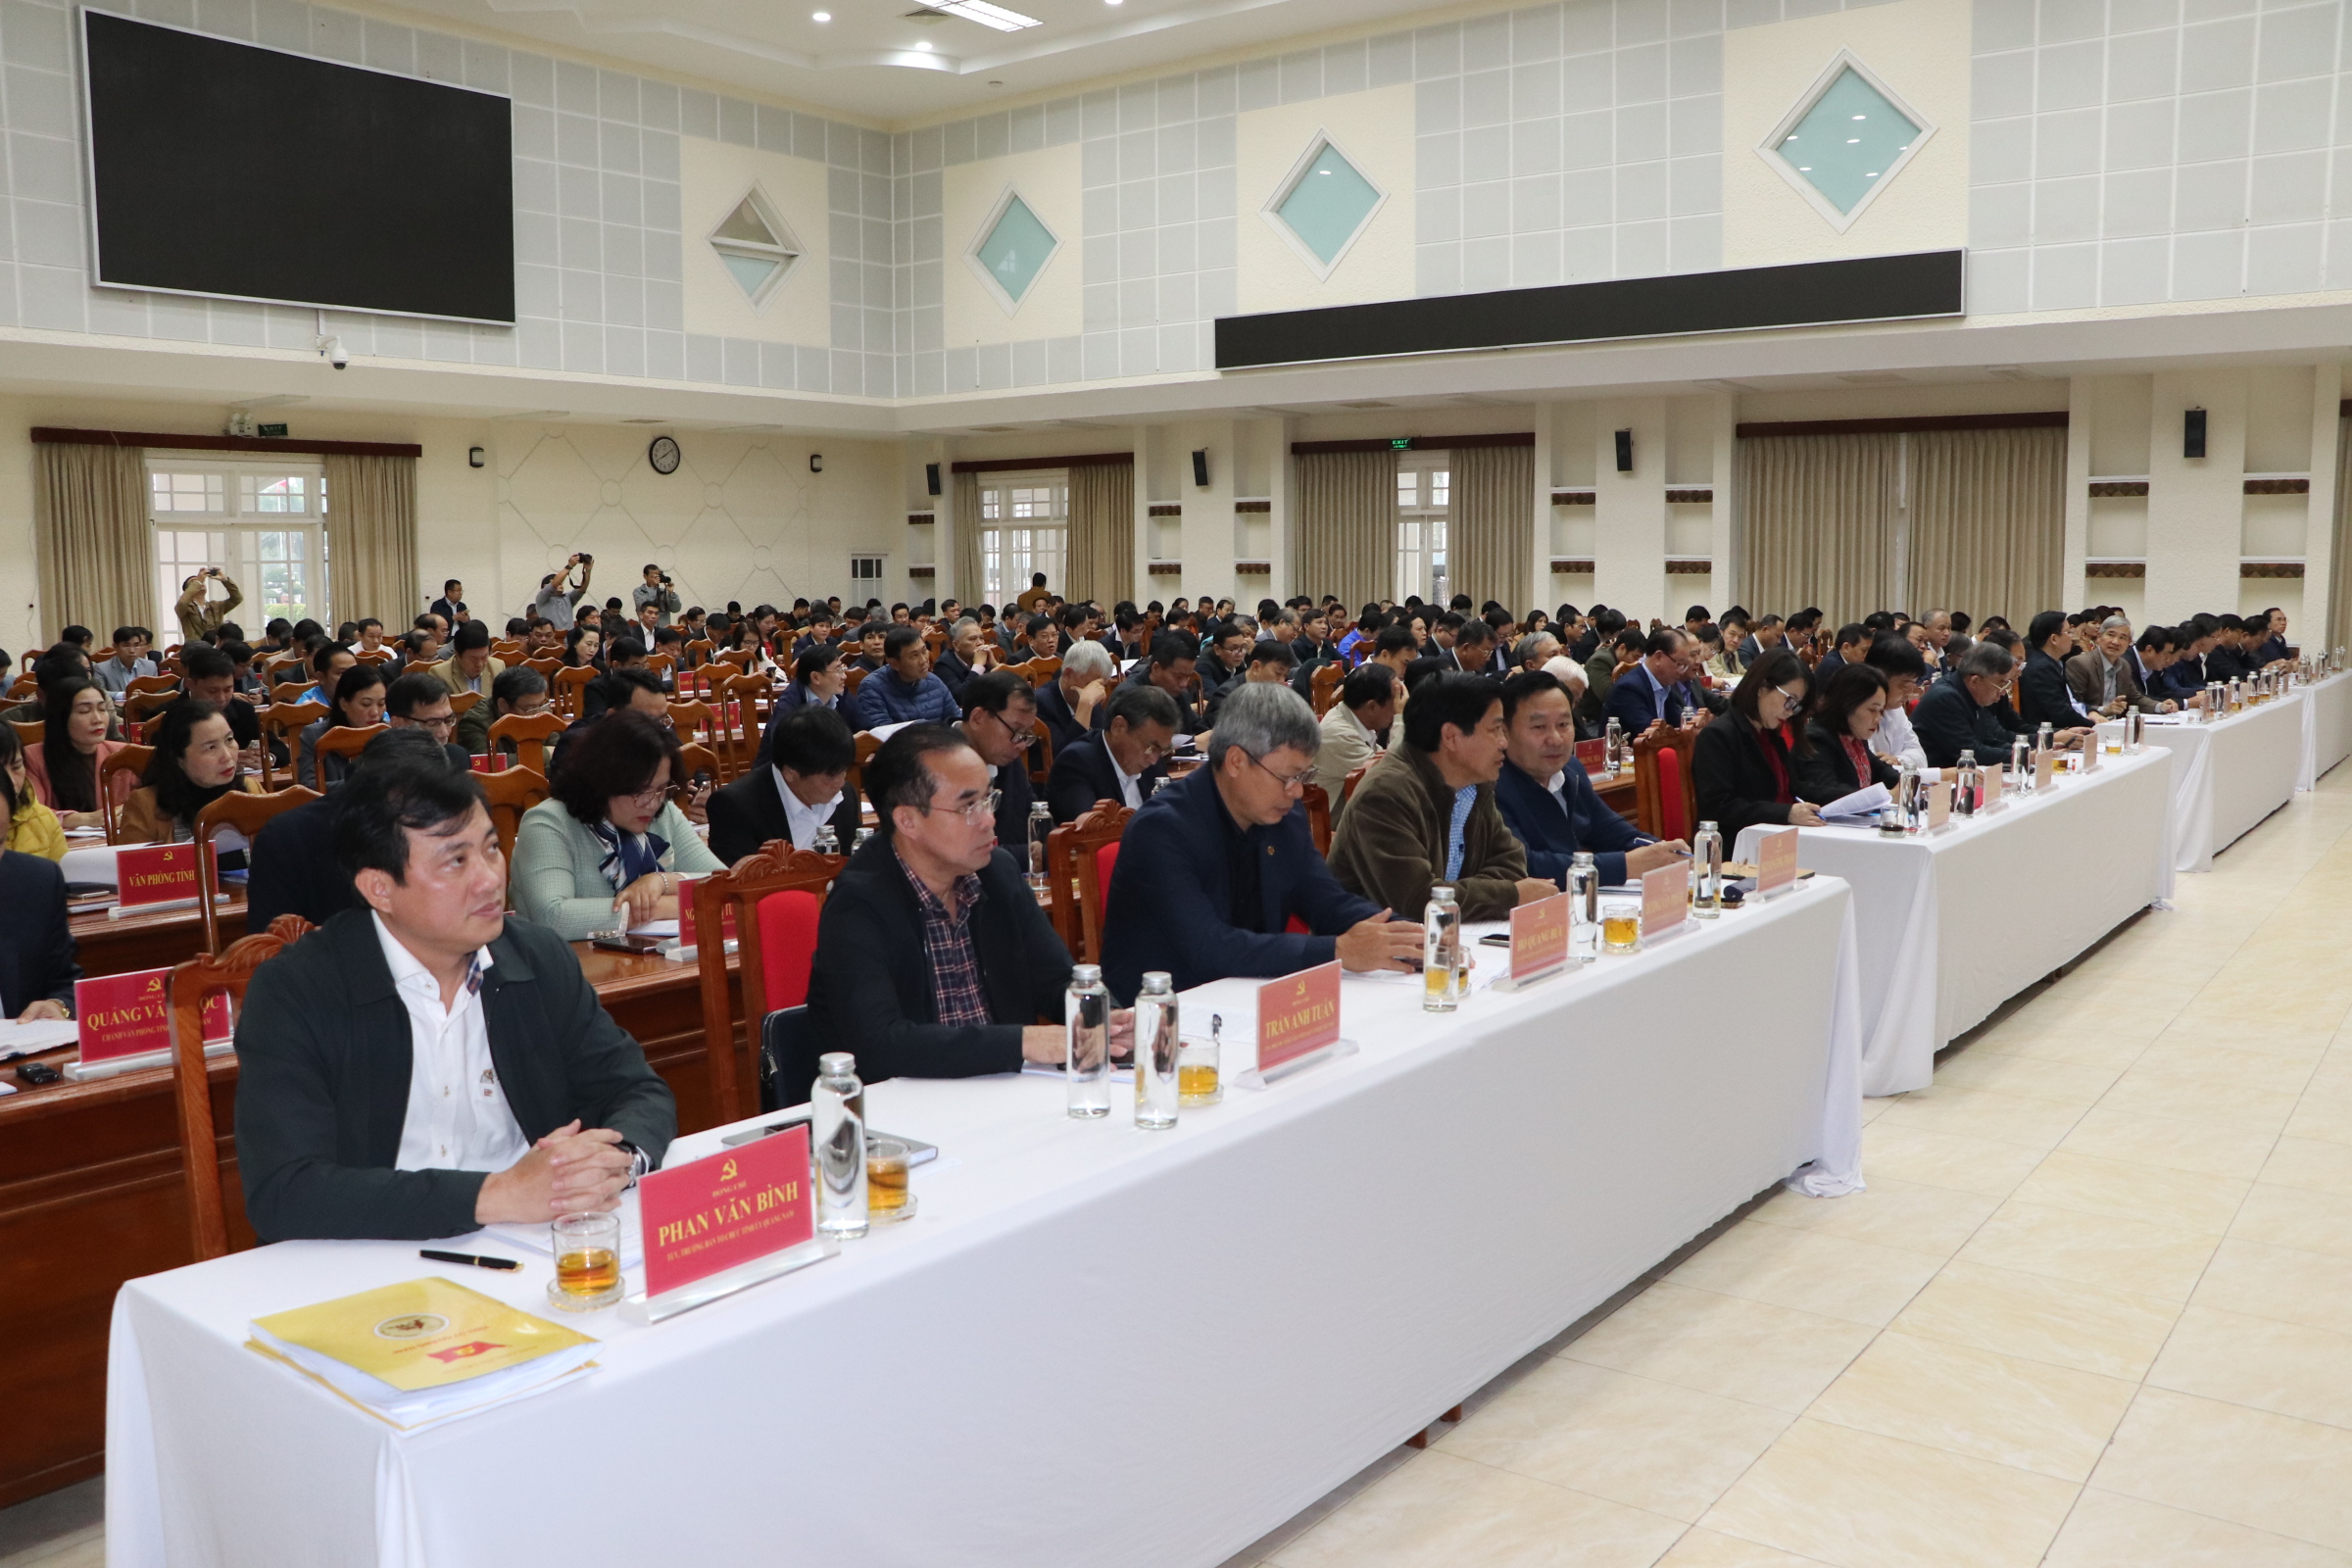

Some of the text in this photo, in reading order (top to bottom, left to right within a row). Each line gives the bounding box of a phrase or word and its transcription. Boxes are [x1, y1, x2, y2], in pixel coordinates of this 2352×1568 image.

[128, 867, 195, 887] VĂN PHÒNG TỈNH
[145, 1000, 169, 1018] VĂ
[1292, 1007, 1310, 1029] ANH
[658, 1181, 799, 1247] PHAN VĂN BÌNH
